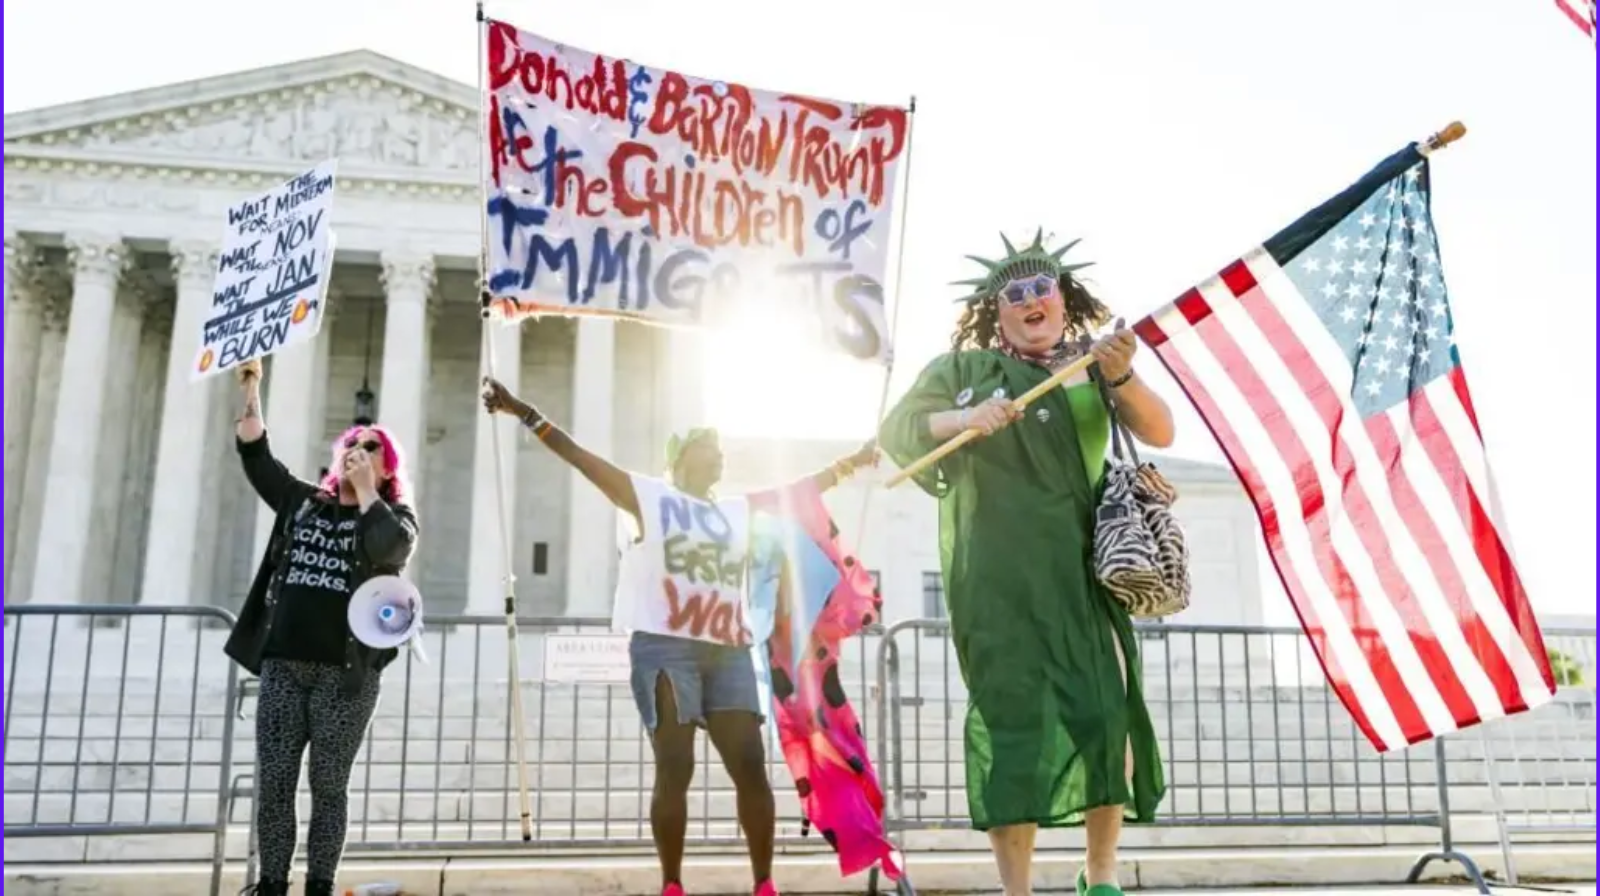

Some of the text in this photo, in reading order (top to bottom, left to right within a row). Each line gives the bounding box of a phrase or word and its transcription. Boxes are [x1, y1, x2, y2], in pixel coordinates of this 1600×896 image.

[488, 21, 627, 121] Donald
[228, 175, 332, 225] WAIT MIDTERM
[286, 169, 318, 192] THE
[219, 208, 324, 272] WAIT NOV
[238, 213, 268, 235] FOR
[814, 199, 873, 259] of
[213, 248, 316, 307] WAIT JAN
[204, 294, 297, 347] WHILE WE
[218, 316, 291, 368] BURN
[660, 496, 733, 542] NO
